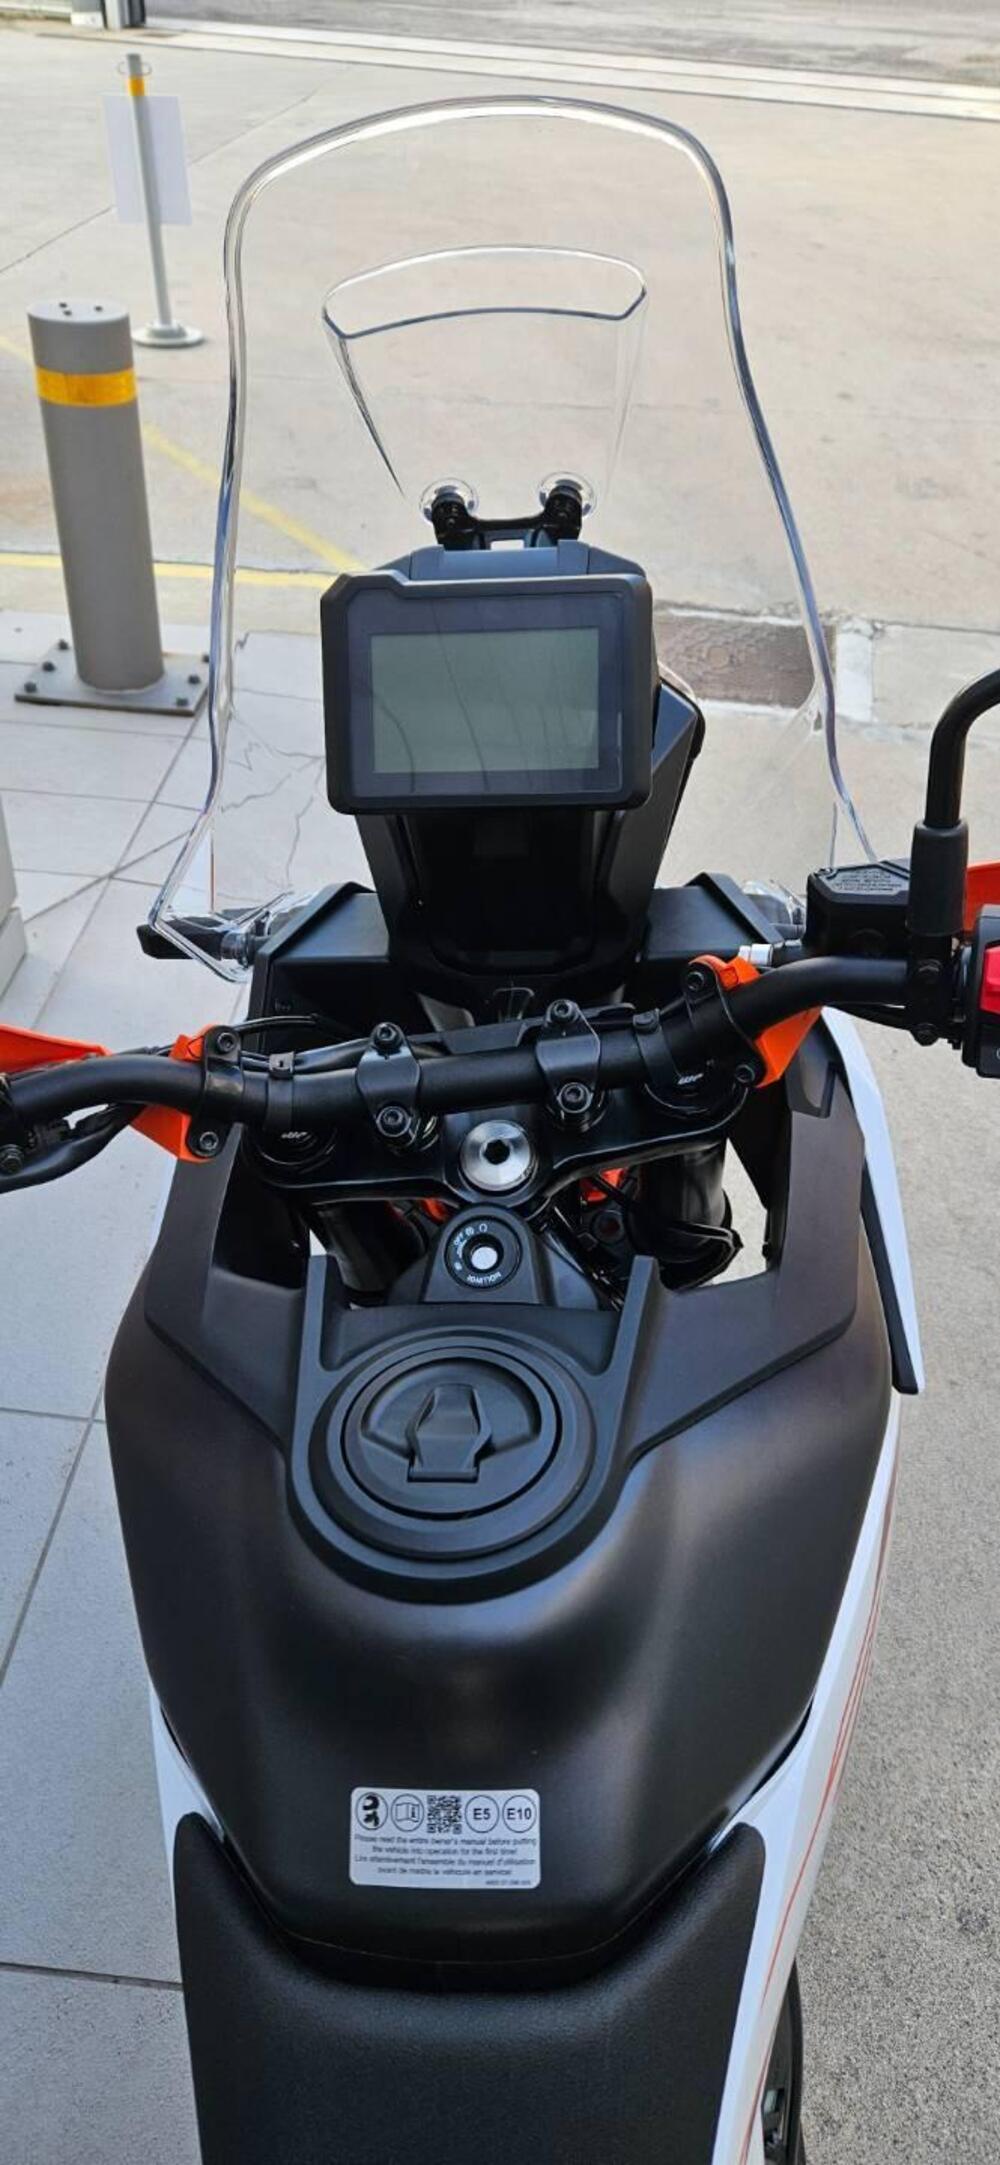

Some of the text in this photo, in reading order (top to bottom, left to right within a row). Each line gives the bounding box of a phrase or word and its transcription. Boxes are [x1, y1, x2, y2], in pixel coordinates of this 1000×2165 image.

[473, 1808, 532, 1820] E5 E10
[460, 1837, 486, 1845] manual
